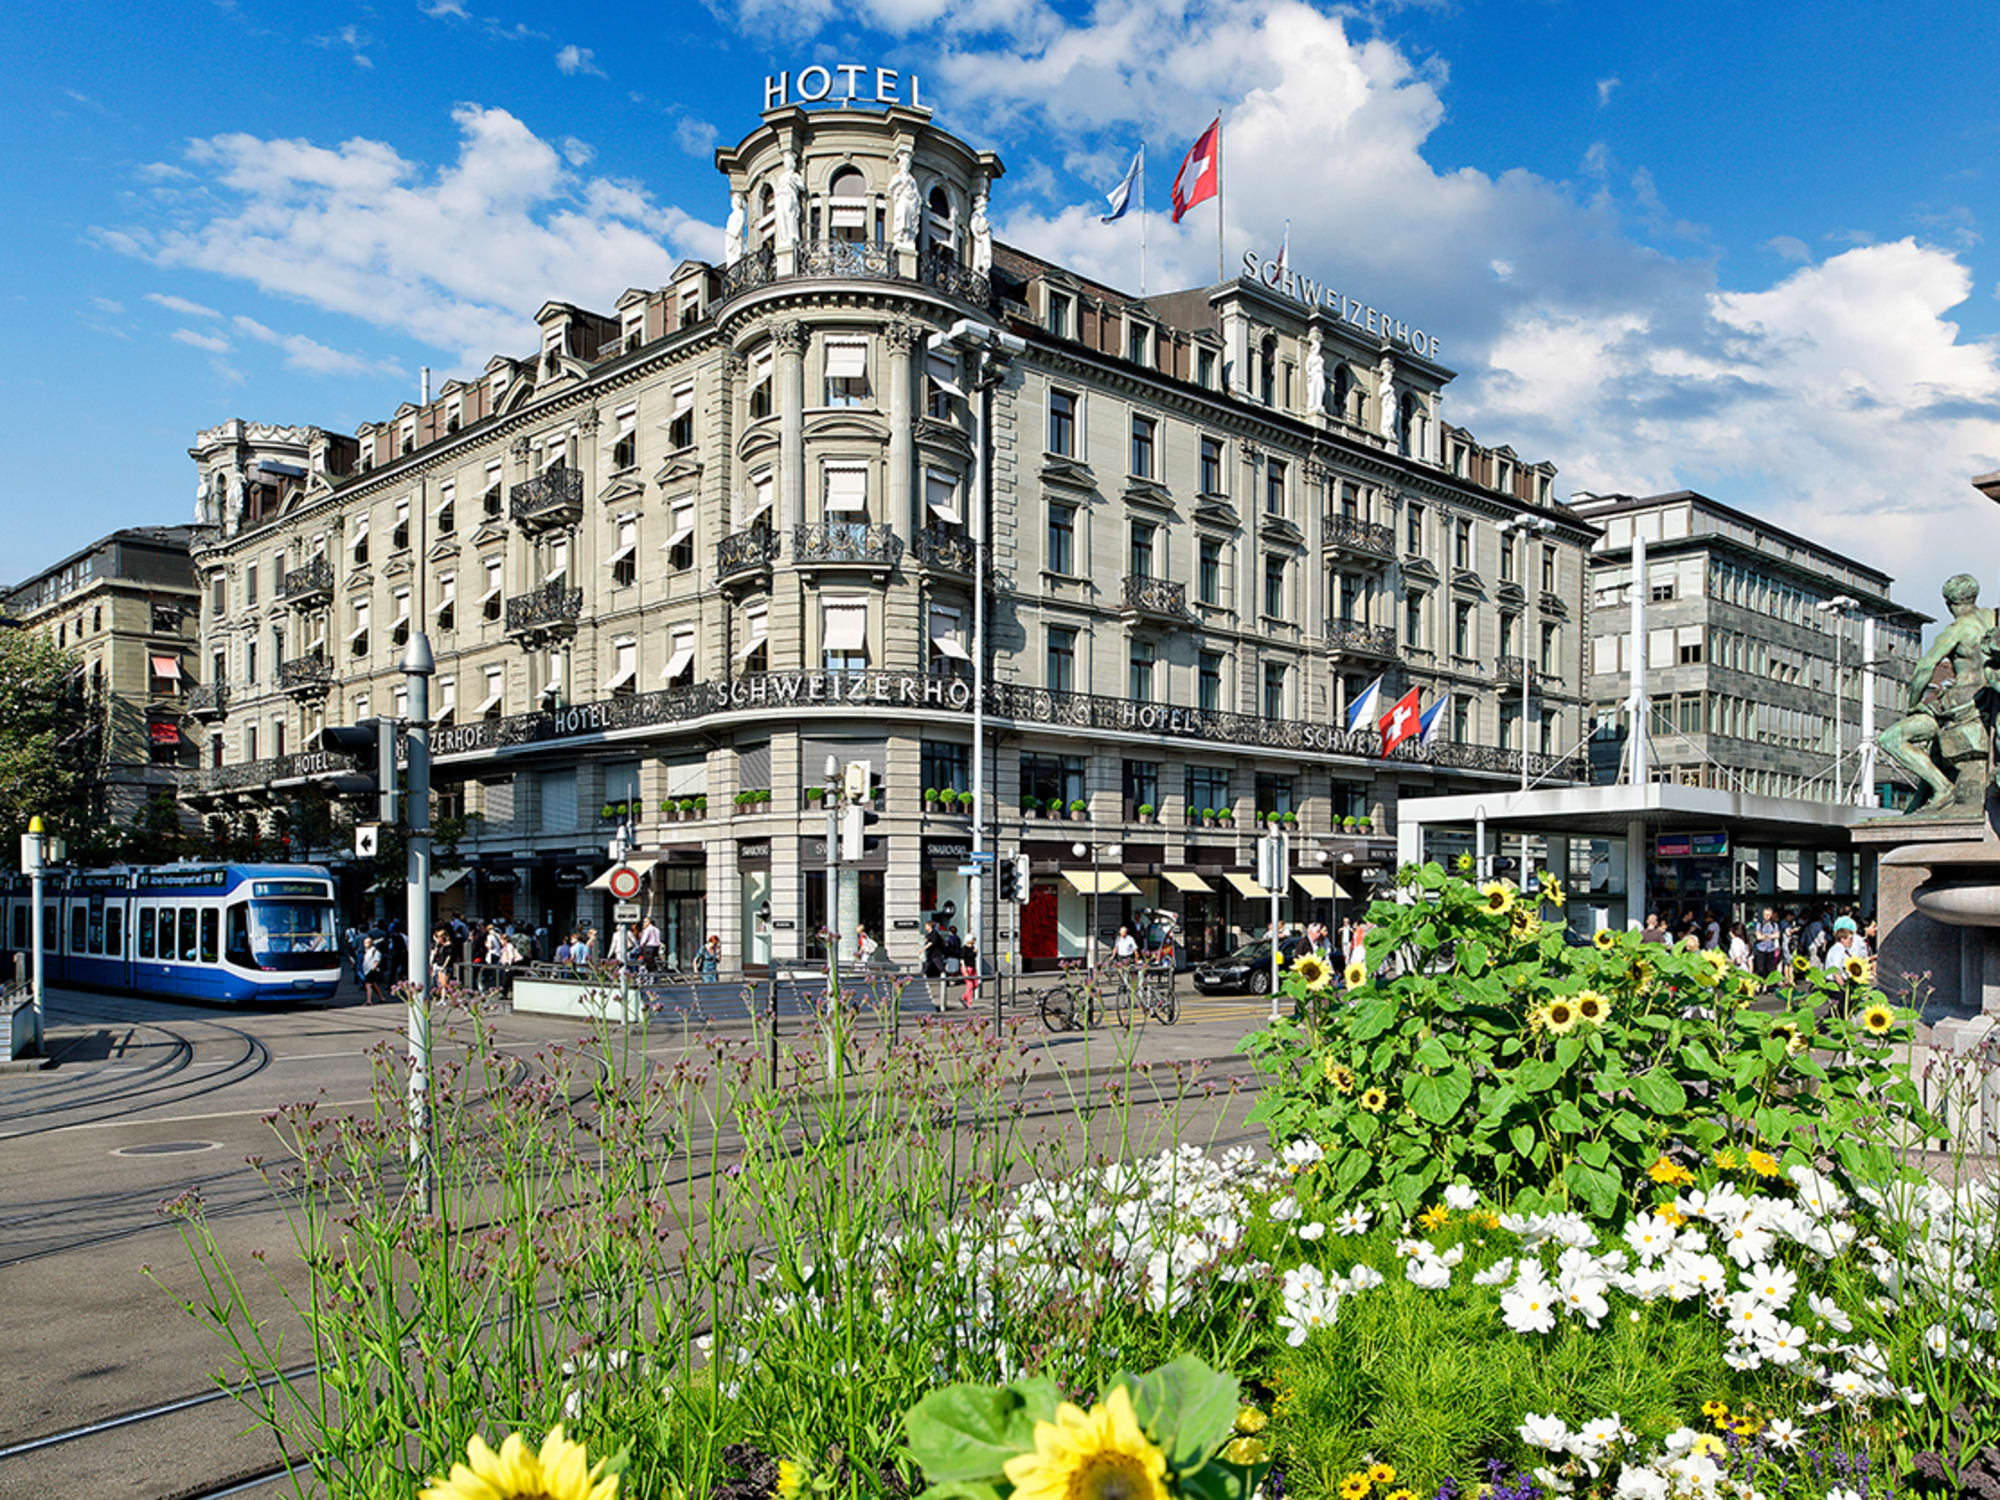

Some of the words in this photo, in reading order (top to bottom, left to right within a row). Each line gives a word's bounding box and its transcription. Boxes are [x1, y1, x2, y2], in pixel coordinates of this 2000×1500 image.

[764, 64, 933, 113] HOTEL
[1242, 249, 1440, 360] SCHWEIZERHOF
[556, 707, 611, 733] HOTEL
[717, 674, 986, 707] SCHWEIZERHO
[1122, 703, 1196, 733] HOTEL
[1303, 726, 1437, 762] SCHWEIZHOF
[294, 752, 330, 776] HOTEL
